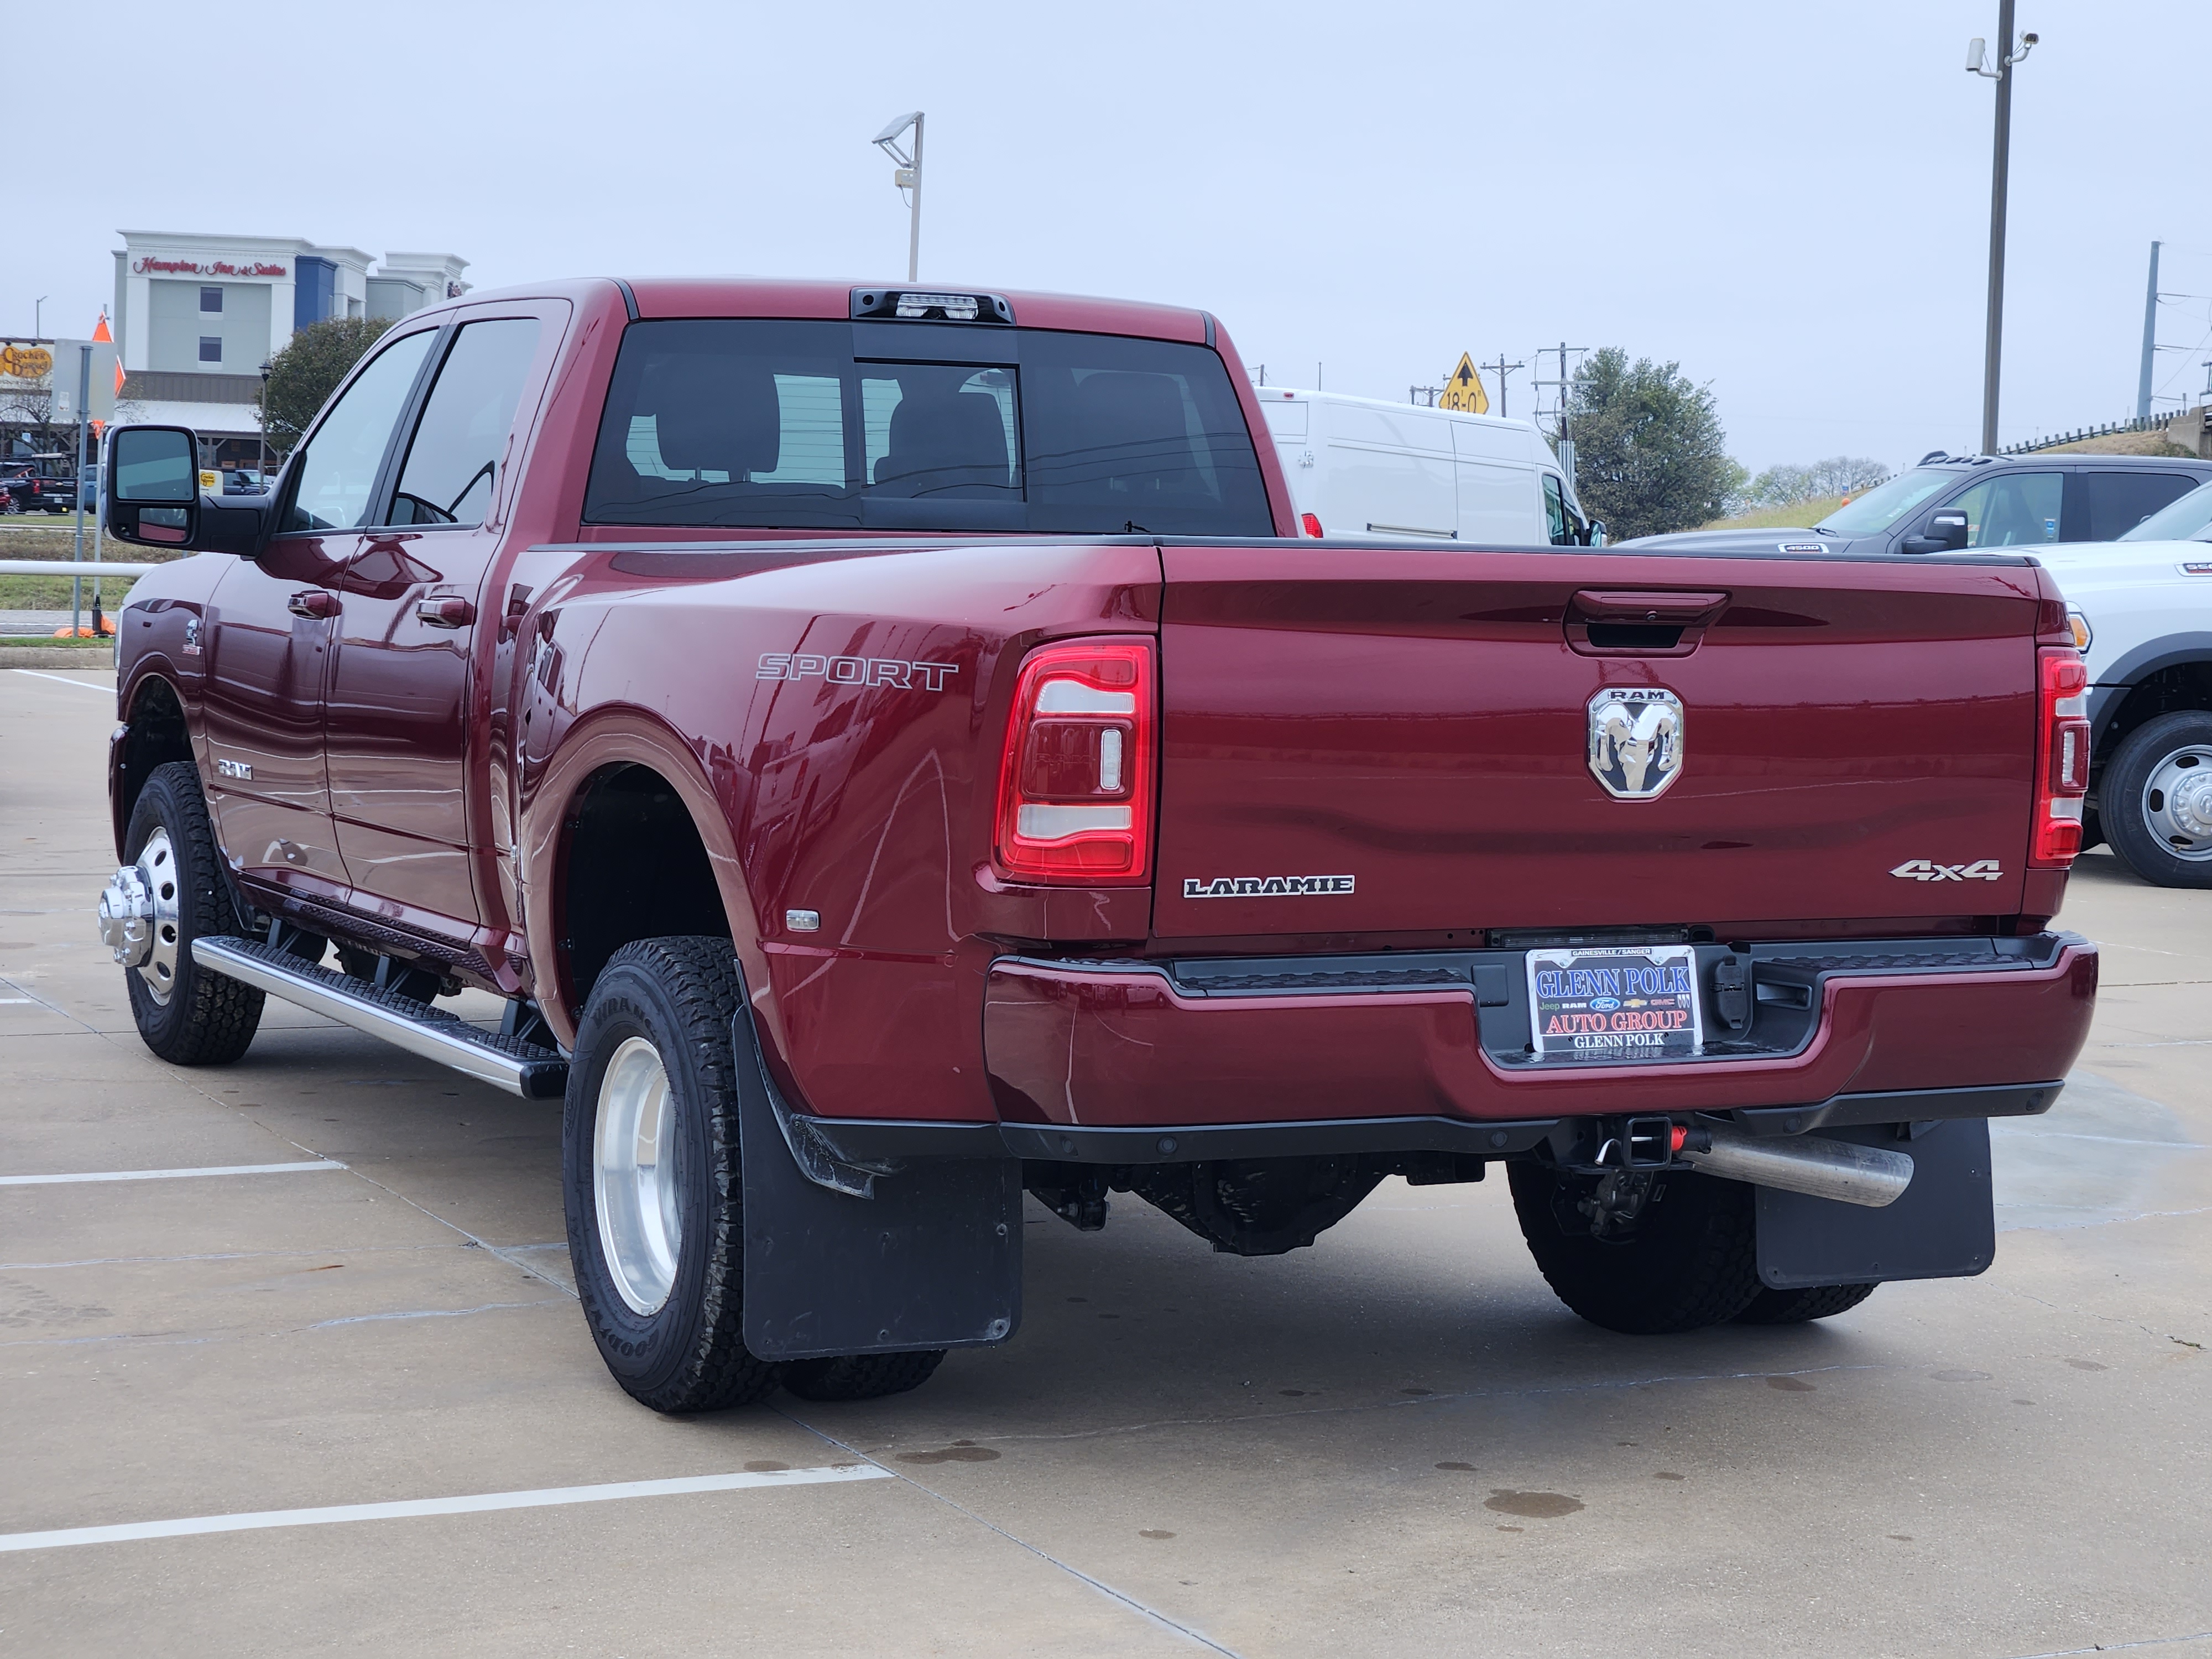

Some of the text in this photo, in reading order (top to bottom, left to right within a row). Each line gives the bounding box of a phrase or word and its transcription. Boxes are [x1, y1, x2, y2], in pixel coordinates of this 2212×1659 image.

[133, 256, 286, 276] Hampton Inn & Suites
[4, 347, 46, 363] Cracker
[755, 653, 959, 691] SPORT
[218, 759, 253, 780] RAM
[1888, 860, 2004, 881] 4x4
[1183, 875, 1355, 898] LARAMIE
[1536, 966, 1691, 999] GLENN POLK
[1540, 1002, 1560, 1011] Jeep
[1595, 999, 1615, 1009] Ford
[1546, 1010, 1687, 1035] AUTO GROUP
[1574, 1032, 1666, 1048] GLENN POLK
